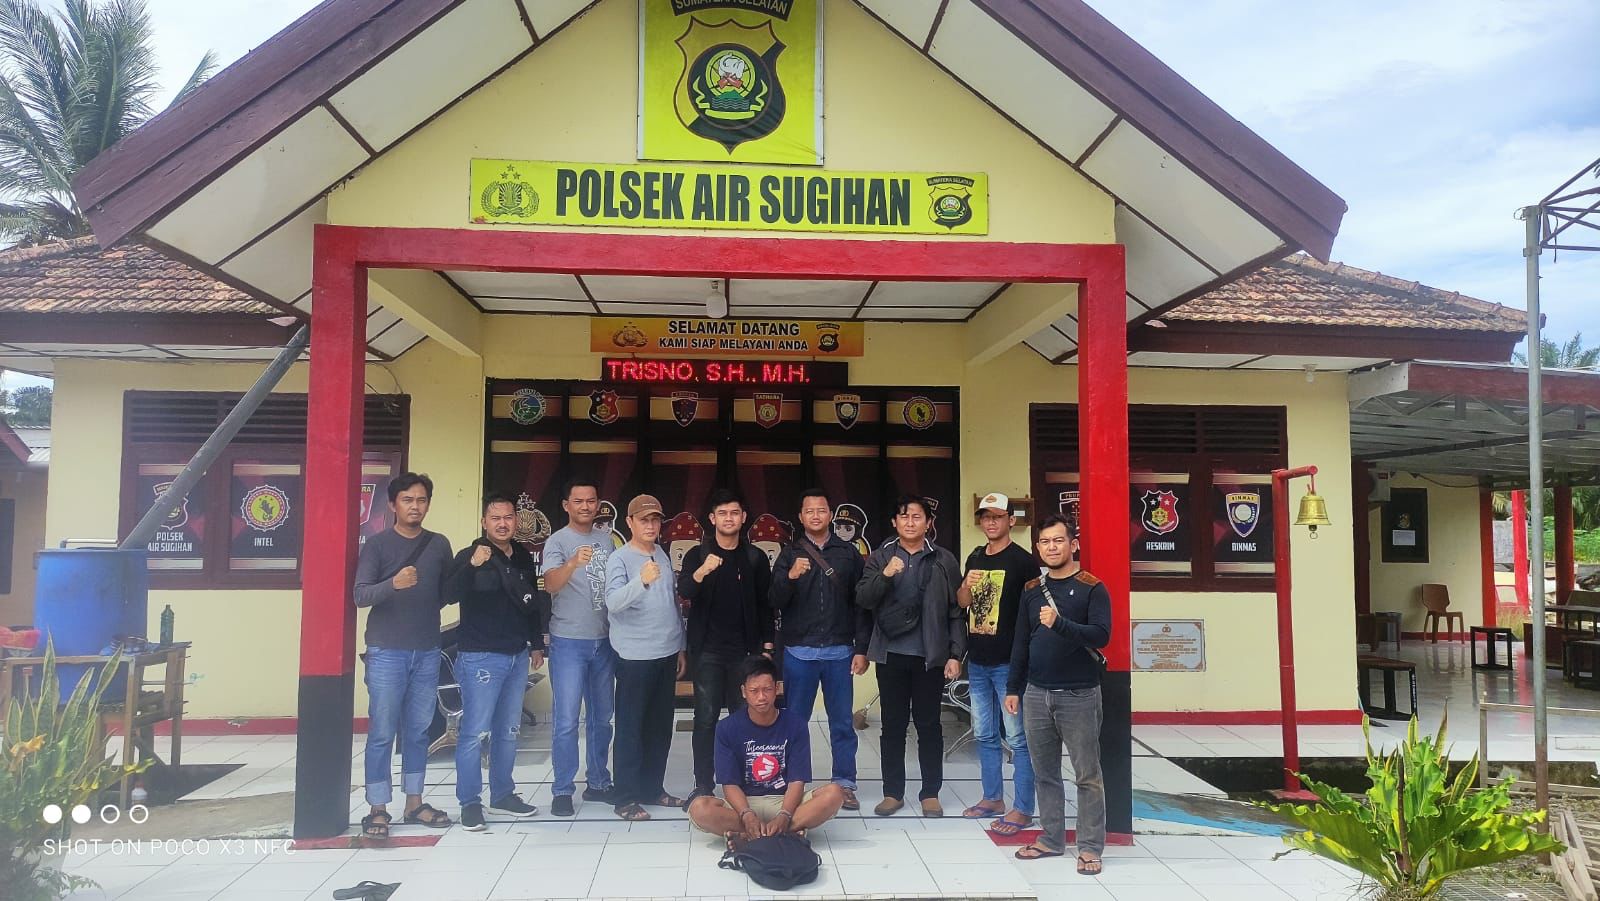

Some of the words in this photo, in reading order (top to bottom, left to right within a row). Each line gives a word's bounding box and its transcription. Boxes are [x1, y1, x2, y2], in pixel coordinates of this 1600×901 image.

[556, 168, 684, 219] POLSEK
[693, 174, 751, 221] AIR
[760, 177, 911, 226] SUGIHAN
[668, 320, 737, 336] SELAMAT
[741, 322, 800, 336] DATANG
[659, 337, 688, 349] KAMI
[691, 338, 716, 349] SIAP
[719, 339, 776, 350] MELAYANI
[778, 341, 808, 351] ANDA
[156, 532, 184, 541] POLSEK
[147, 542, 160, 552] AIR
[160, 542, 193, 552] SUGIHAN
[254, 537, 274, 547] INTEL
[1146, 541, 1175, 551] RESKRIM
[1231, 542, 1257, 552] BINMAS
